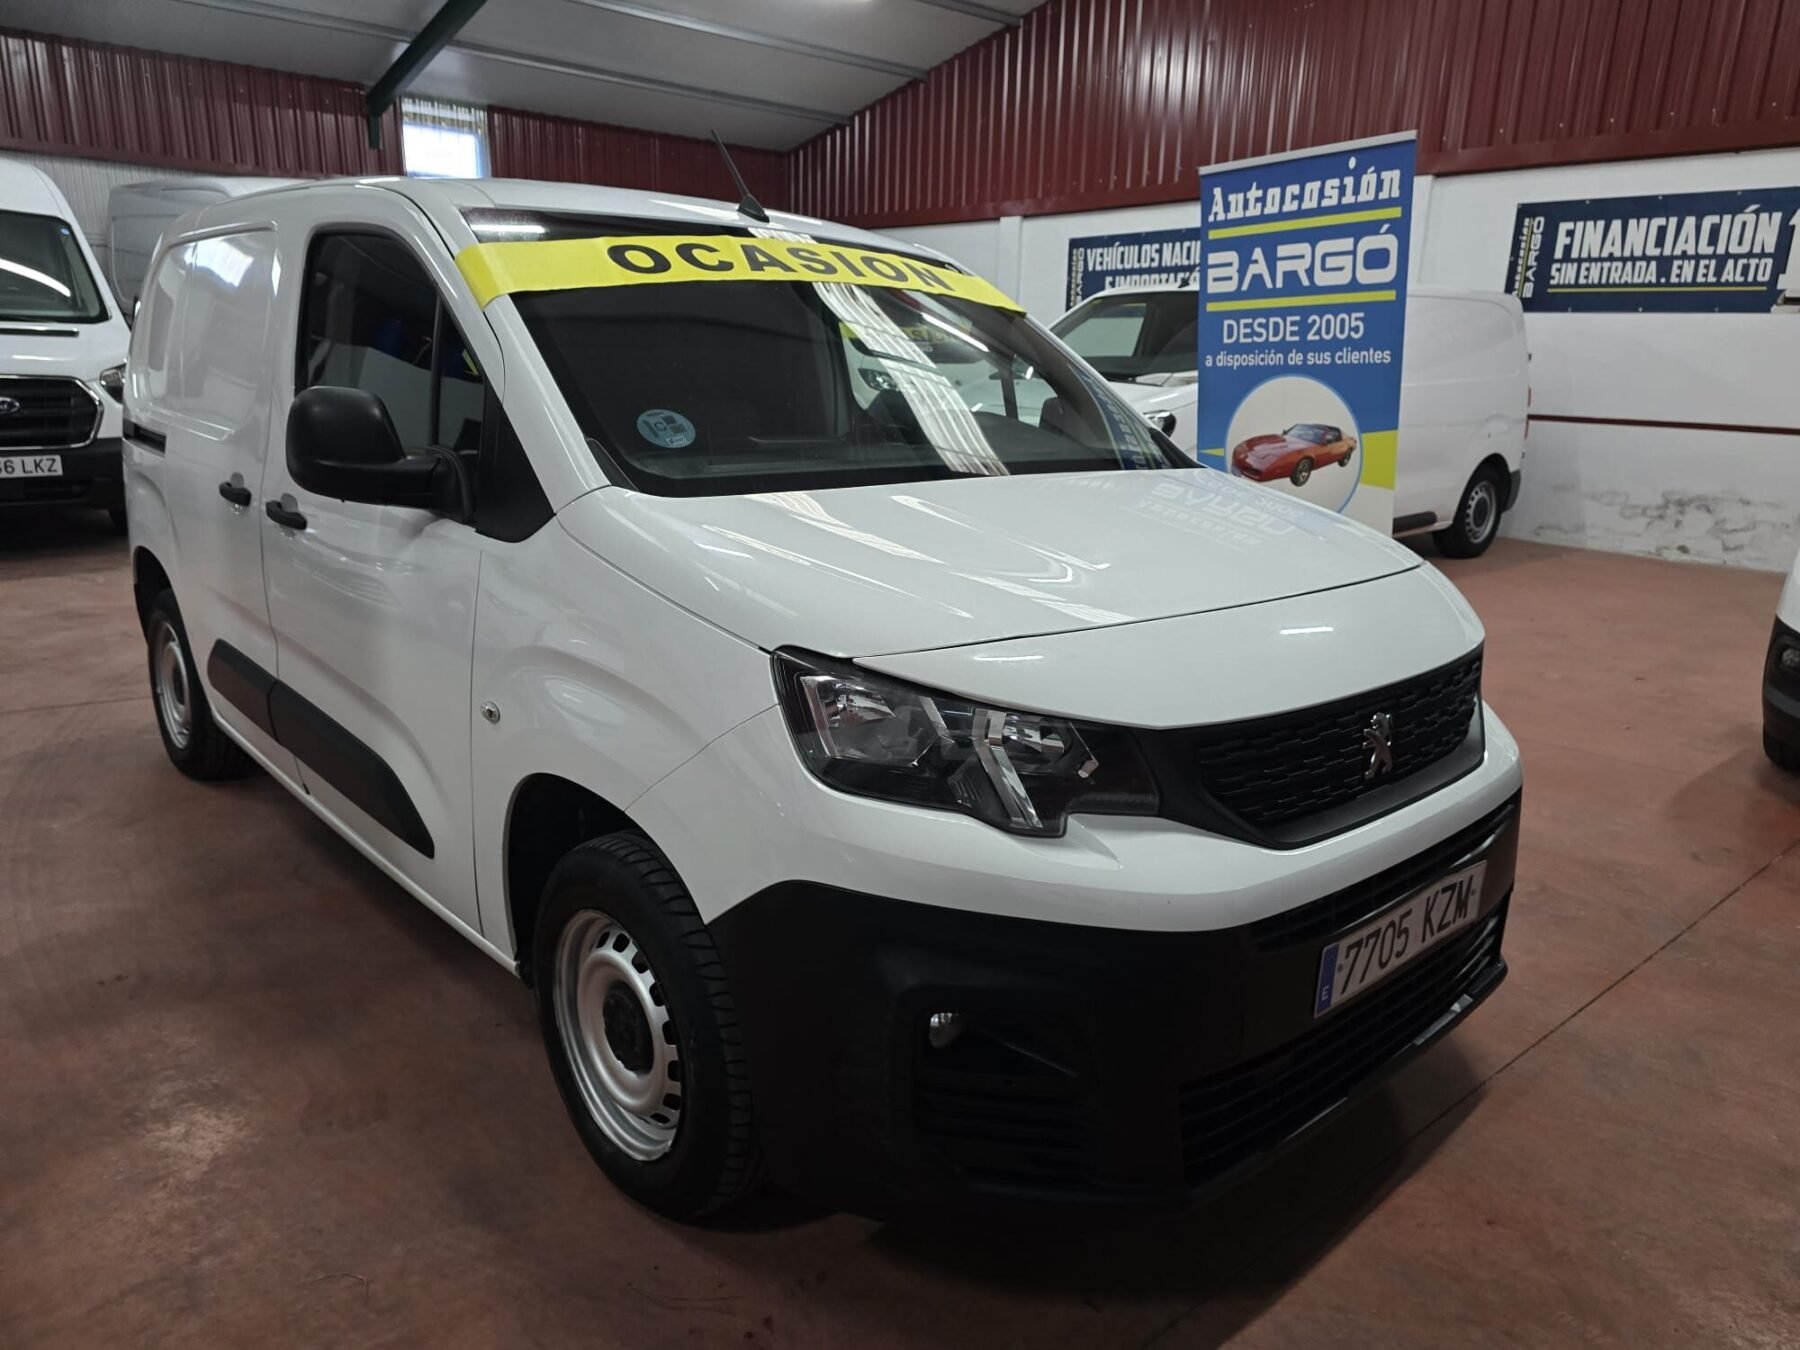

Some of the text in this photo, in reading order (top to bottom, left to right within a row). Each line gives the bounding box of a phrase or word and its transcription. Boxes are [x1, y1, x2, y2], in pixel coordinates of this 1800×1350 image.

[1207, 156, 1401, 223] Autocasión
[1553, 204, 1783, 260] FINANCIACIÓN
[606, 242, 955, 292] OCASION
[1086, 241, 1160, 272] VEHÍCULOS
[1206, 223, 1399, 294] BARGÓ
[1549, 262, 1578, 285] SIN
[1577, 260, 1657, 285] ENTRADA
[1670, 260, 1699, 284] EN
[1699, 259, 1717, 283] EL
[1720, 257, 1774, 283] ACTO
[1222, 312, 1365, 344] DESDE 2005
[1205, 347, 1391, 370] a disposición de sus clientes
[21, 458, 58, 474] LKZ
[1340, 874, 1474, 995] 7705 KZM
